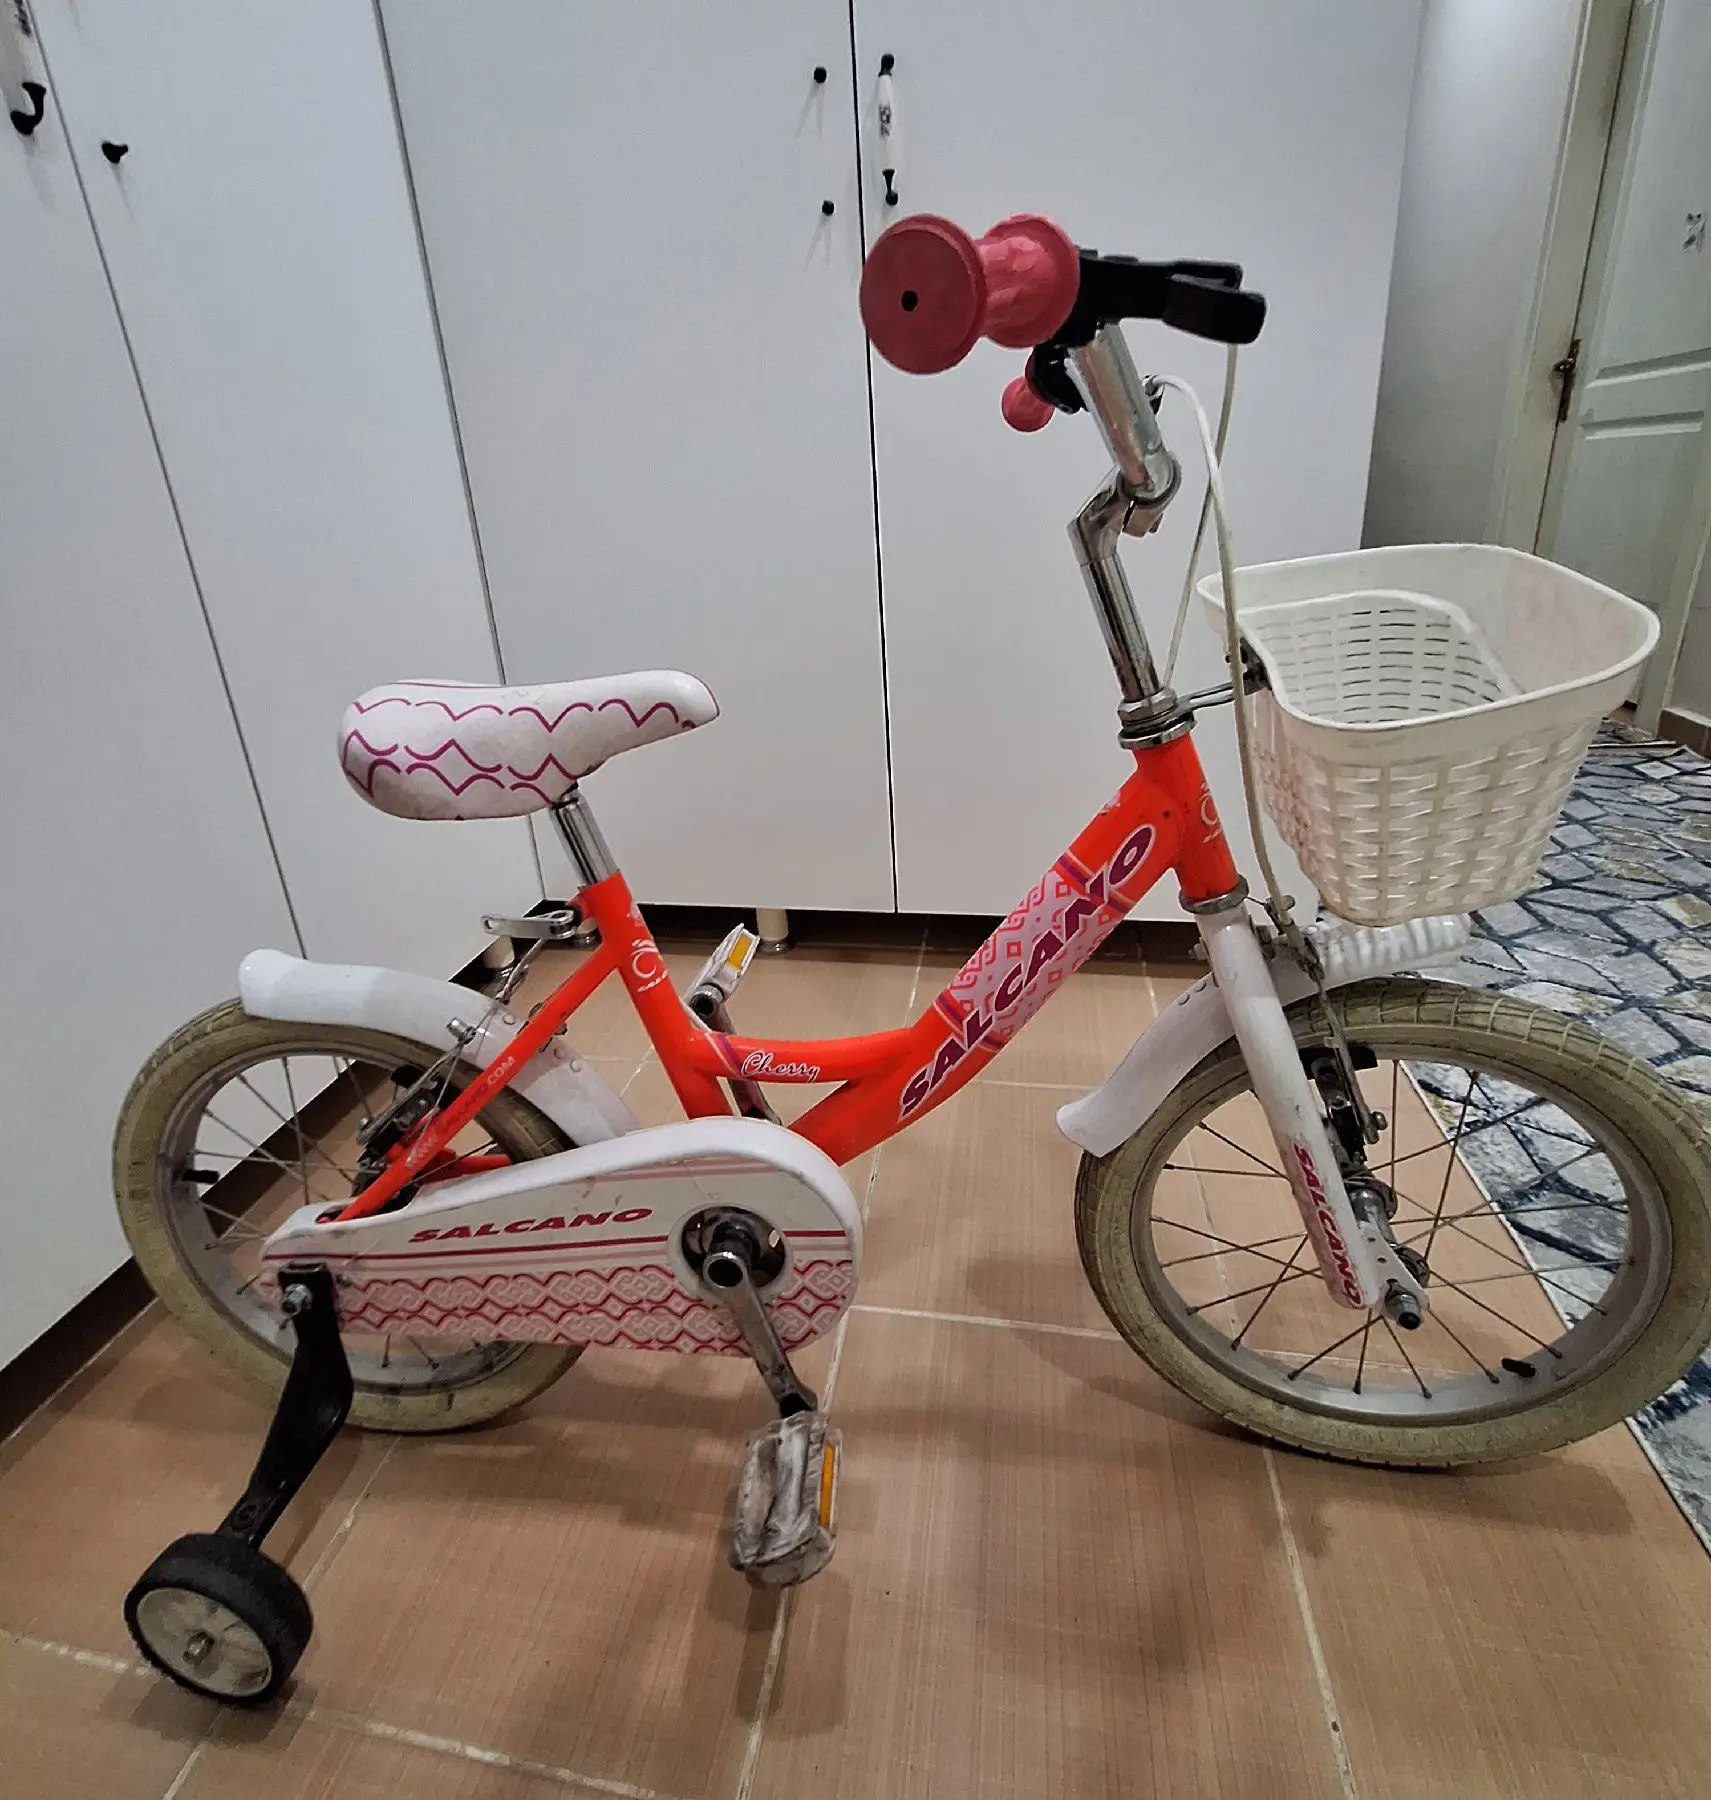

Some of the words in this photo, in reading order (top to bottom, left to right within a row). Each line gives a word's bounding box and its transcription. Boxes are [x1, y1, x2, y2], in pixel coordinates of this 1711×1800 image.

[900, 824, 1156, 1117] SALCANO
[741, 1050, 820, 1083] Cherry
[408, 1207, 654, 1243] SALCANO
